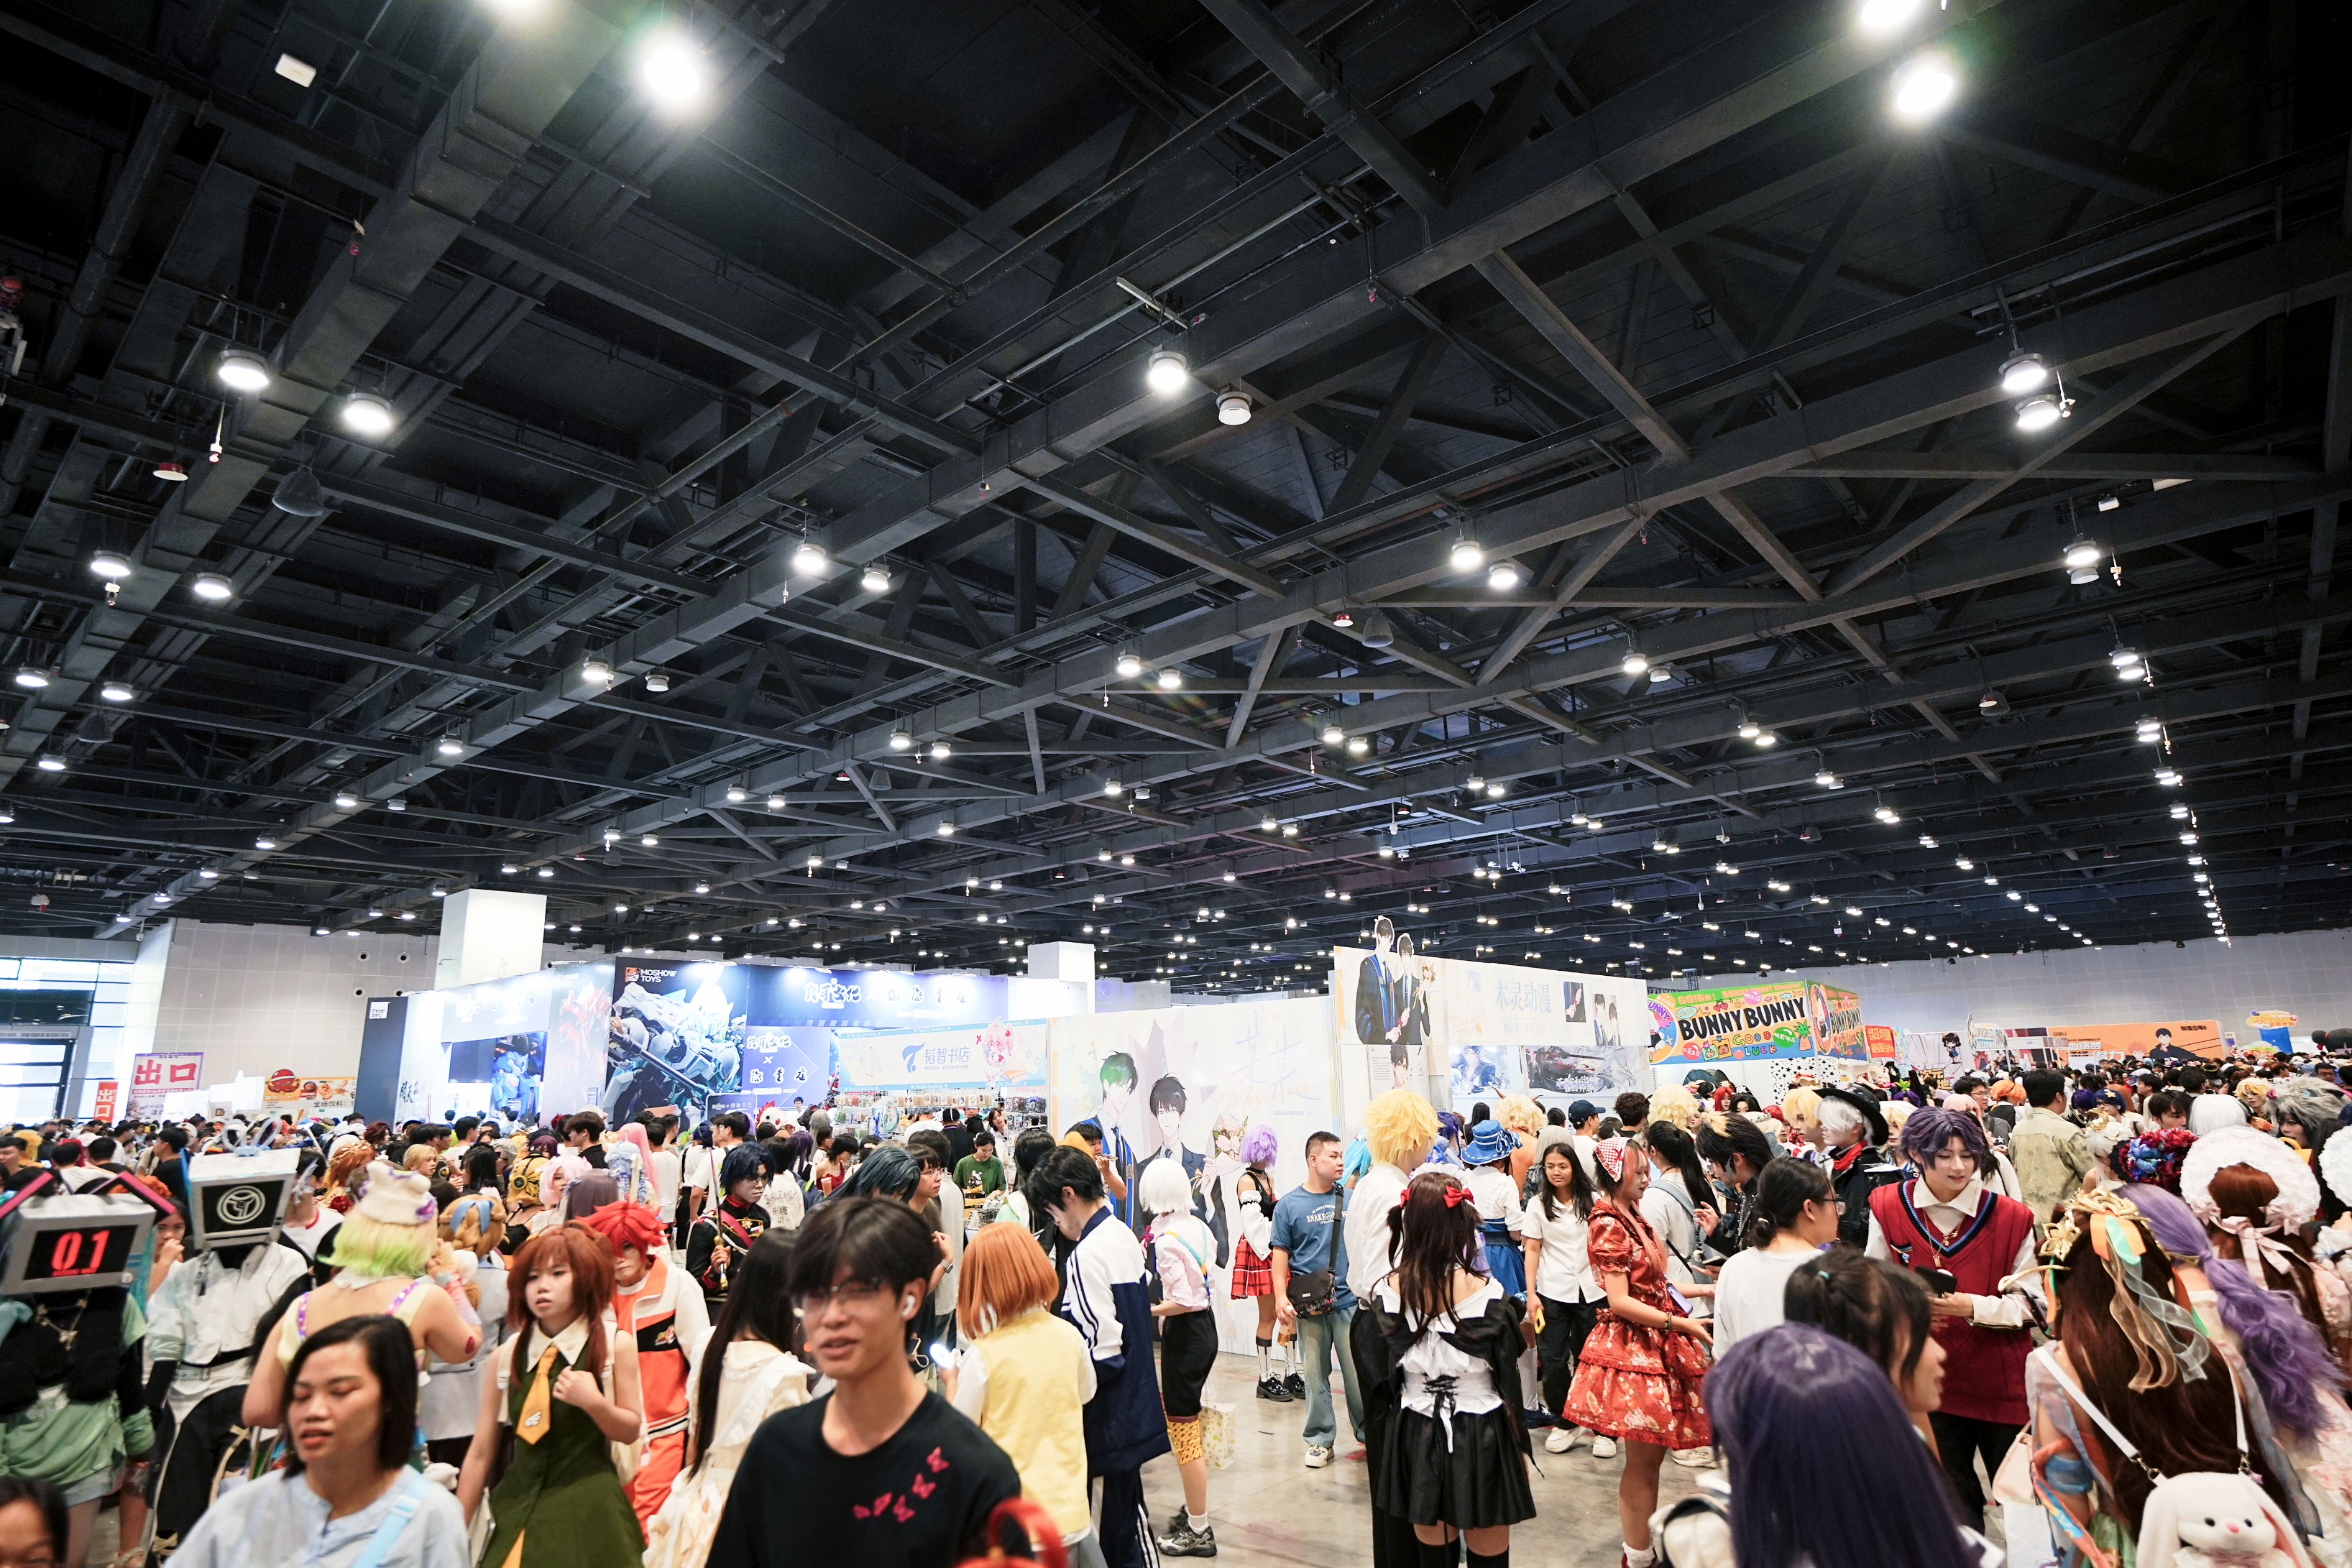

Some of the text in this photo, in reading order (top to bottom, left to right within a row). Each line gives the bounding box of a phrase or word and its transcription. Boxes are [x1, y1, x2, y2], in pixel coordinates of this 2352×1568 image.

[1494, 979, 1551, 1013] 木灵动漫
[1648, 1001, 1671, 1020] UNNY
[1678, 997, 1805, 1040] BUNNY BUNNY
[1733, 1031, 1772, 1046] GOOD
[1745, 1045, 1777, 1056] LUCK
[135, 1059, 197, 1085] 出口
[95, 1088, 113, 1117] 出口
[1306, 1213, 1326, 1223] SNAKE
[51, 1229, 110, 1276] 01
